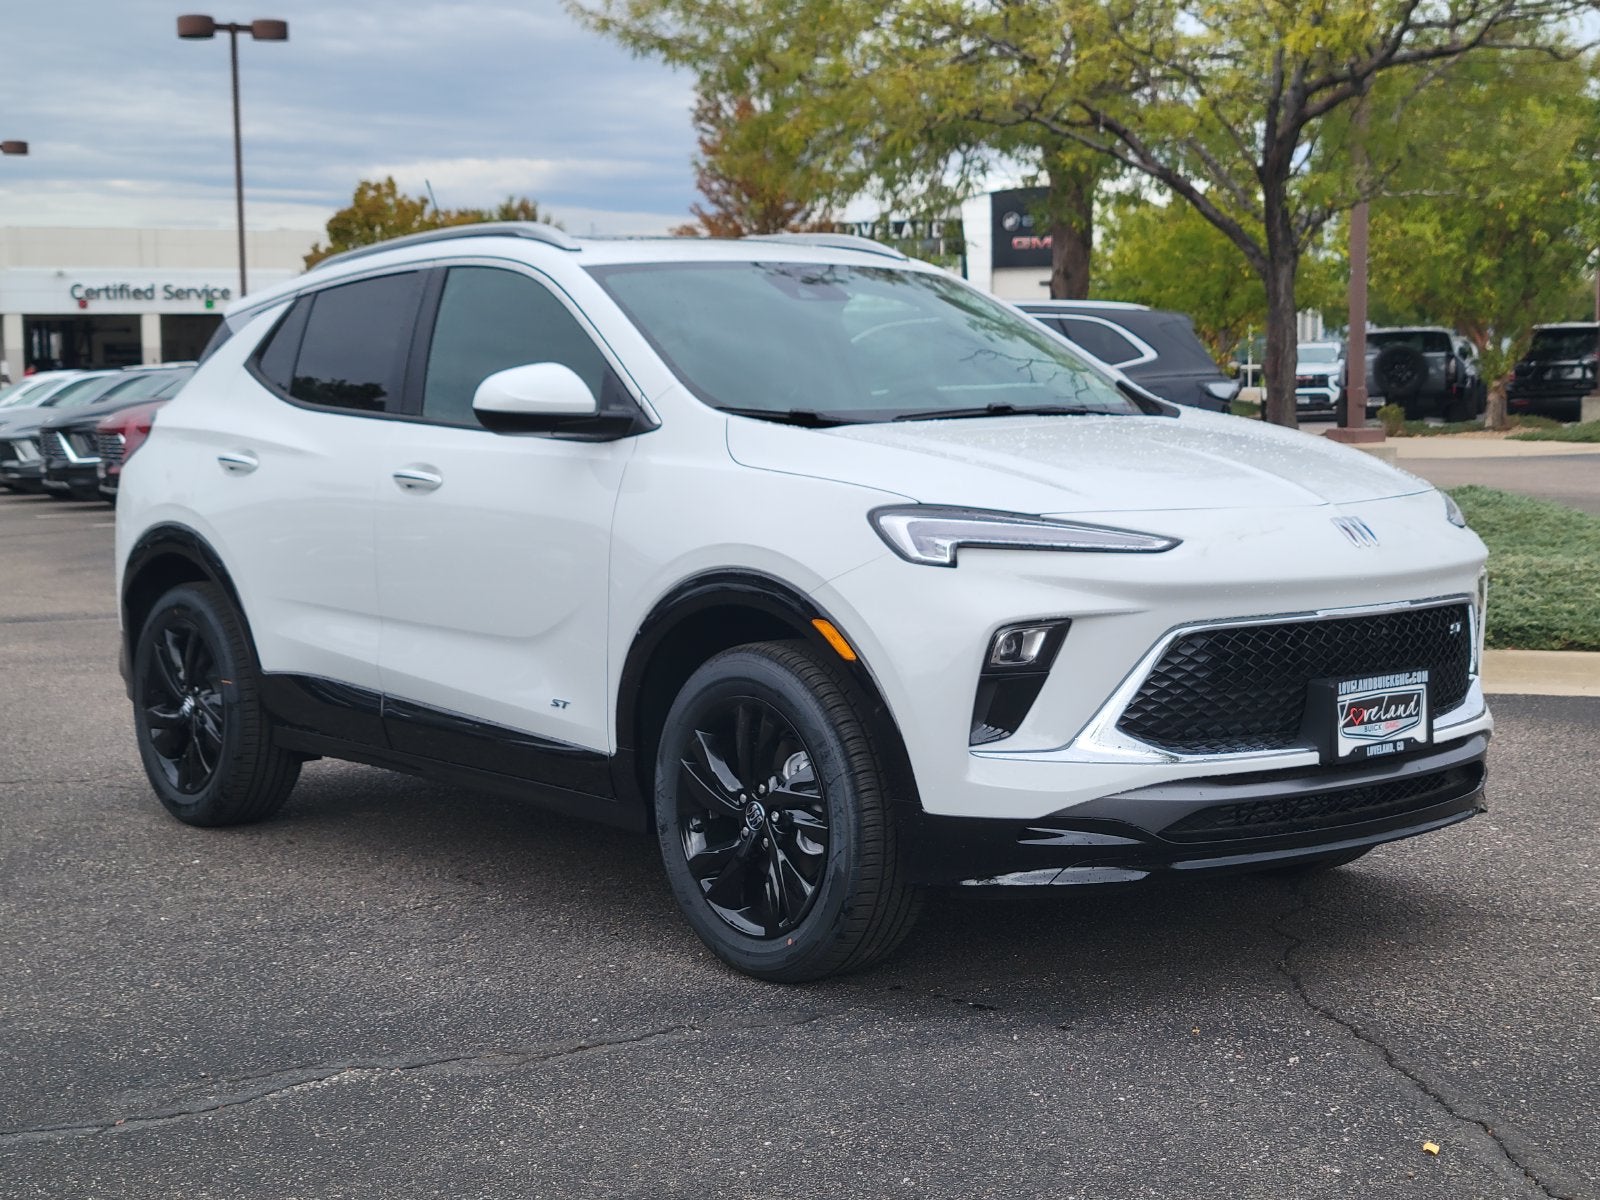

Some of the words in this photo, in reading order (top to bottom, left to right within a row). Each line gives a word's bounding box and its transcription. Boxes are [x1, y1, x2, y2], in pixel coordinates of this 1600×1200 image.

[1012, 236, 1053, 250] GM
[71, 283, 156, 300] Certified
[163, 284, 231, 301] Service
[1338, 670, 1429, 695] LOVELANDBUICKGMC.COM
[550, 698, 571, 710] ST
[1338, 694, 1419, 728] Loveland
[1364, 723, 1382, 733] BUICK
[1366, 742, 1396, 757] LOVELAND,
[1396, 741, 1405, 752] CO
